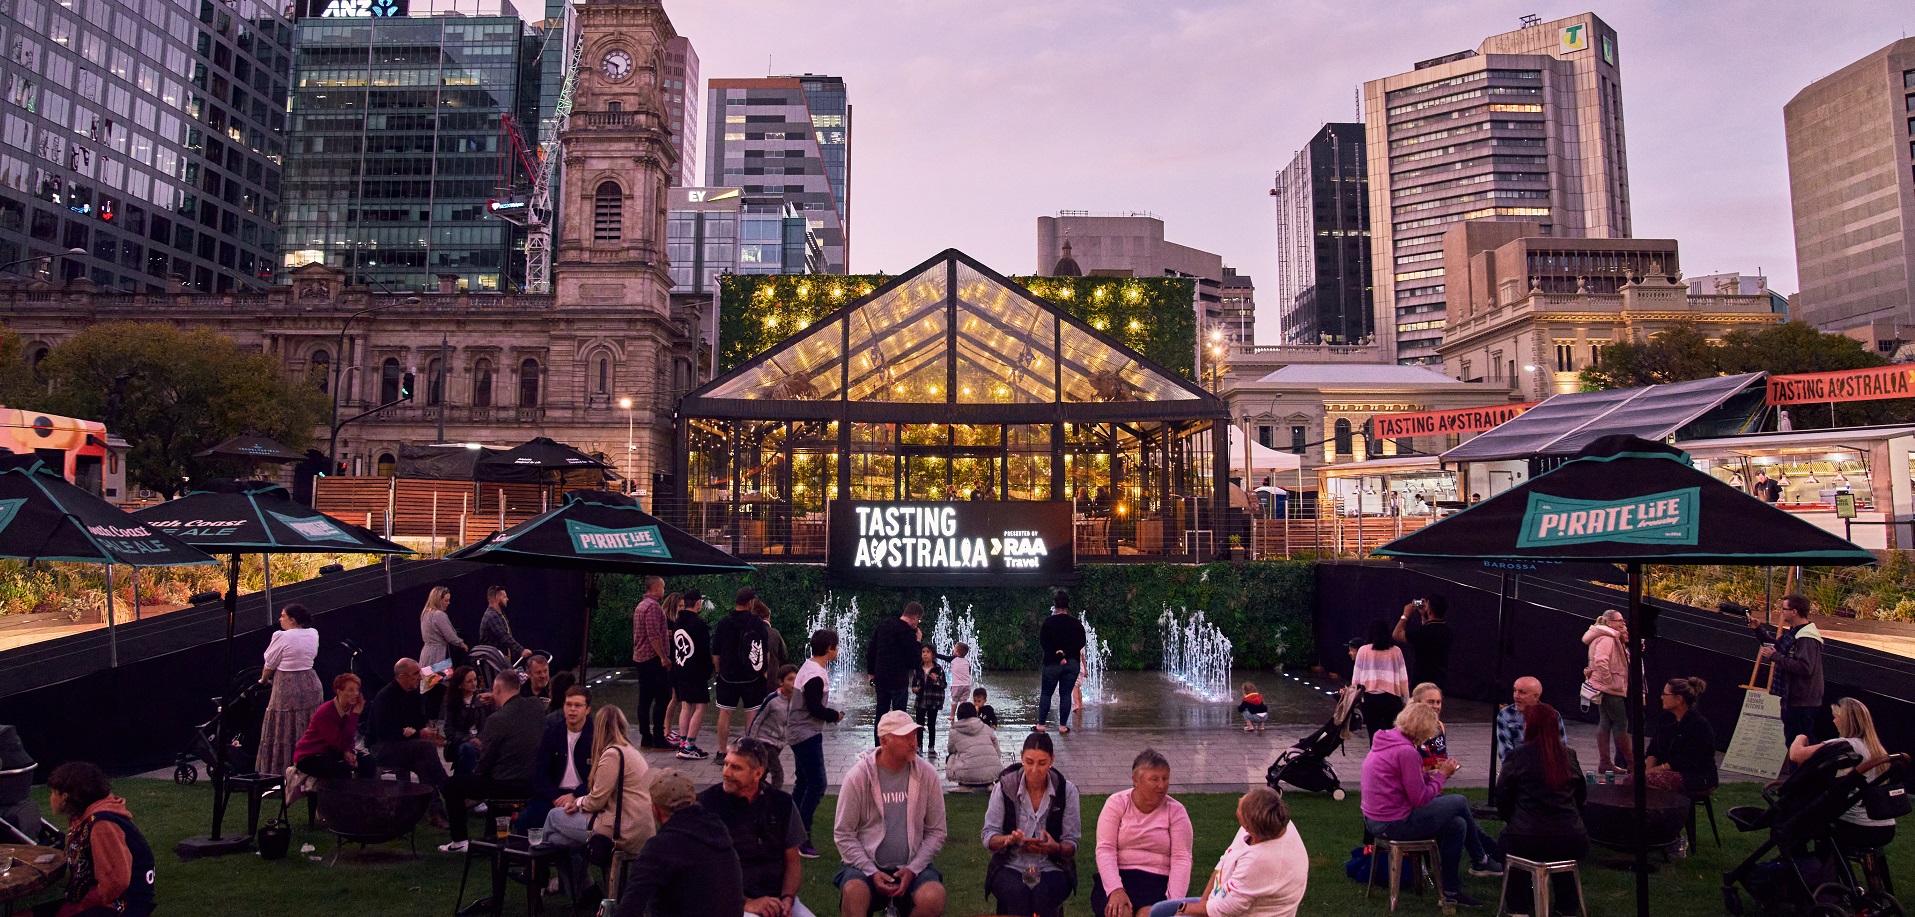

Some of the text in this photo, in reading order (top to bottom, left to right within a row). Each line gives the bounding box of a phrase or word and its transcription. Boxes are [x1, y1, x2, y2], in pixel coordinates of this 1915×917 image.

[321, 0, 372, 17] ANZ
[689, 190, 706, 202] EY
[1772, 378, 1824, 401] TASTING
[1379, 415, 1435, 436] TASTING
[184, 519, 248, 527] Coast
[856, 507, 956, 536] TASTING
[109, 525, 152, 538] Coast
[177, 527, 238, 536] ALE
[133, 540, 171, 554] ALE
[1004, 537, 1047, 556] RAA
[1004, 556, 1039, 568] Travel
[1483, 560, 1537, 570] BAROSSA
